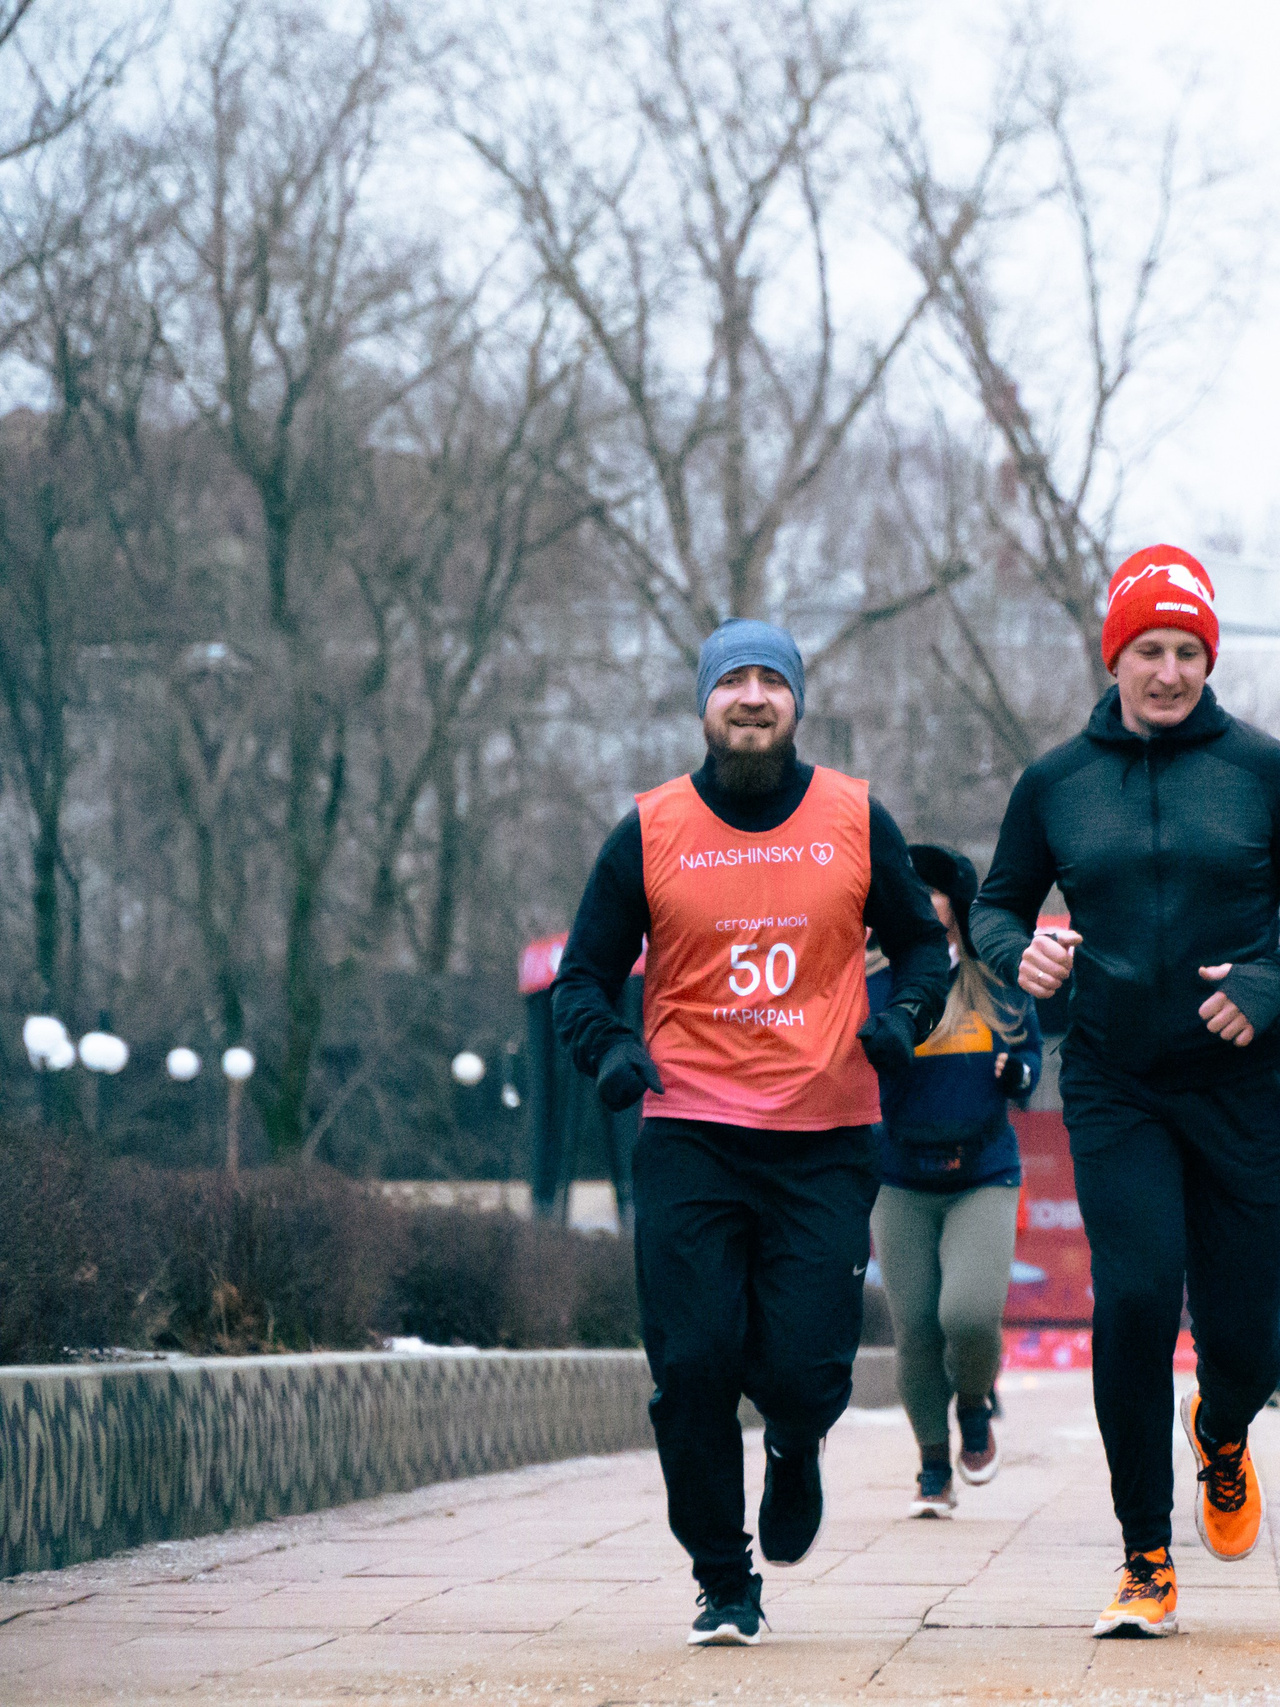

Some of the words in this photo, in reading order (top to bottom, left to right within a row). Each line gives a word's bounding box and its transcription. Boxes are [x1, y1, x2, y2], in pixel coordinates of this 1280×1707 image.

[1155, 602, 1181, 611] NEW
[1180, 603, 1199, 616] ERA
[680, 846, 804, 870] NATASHINSKY
[715, 916, 774, 931] СЕГОДНЯ
[777, 914, 808, 928] МОЙ
[728, 942, 796, 996] 50
[713, 1007, 804, 1026] ПАРКРАН
